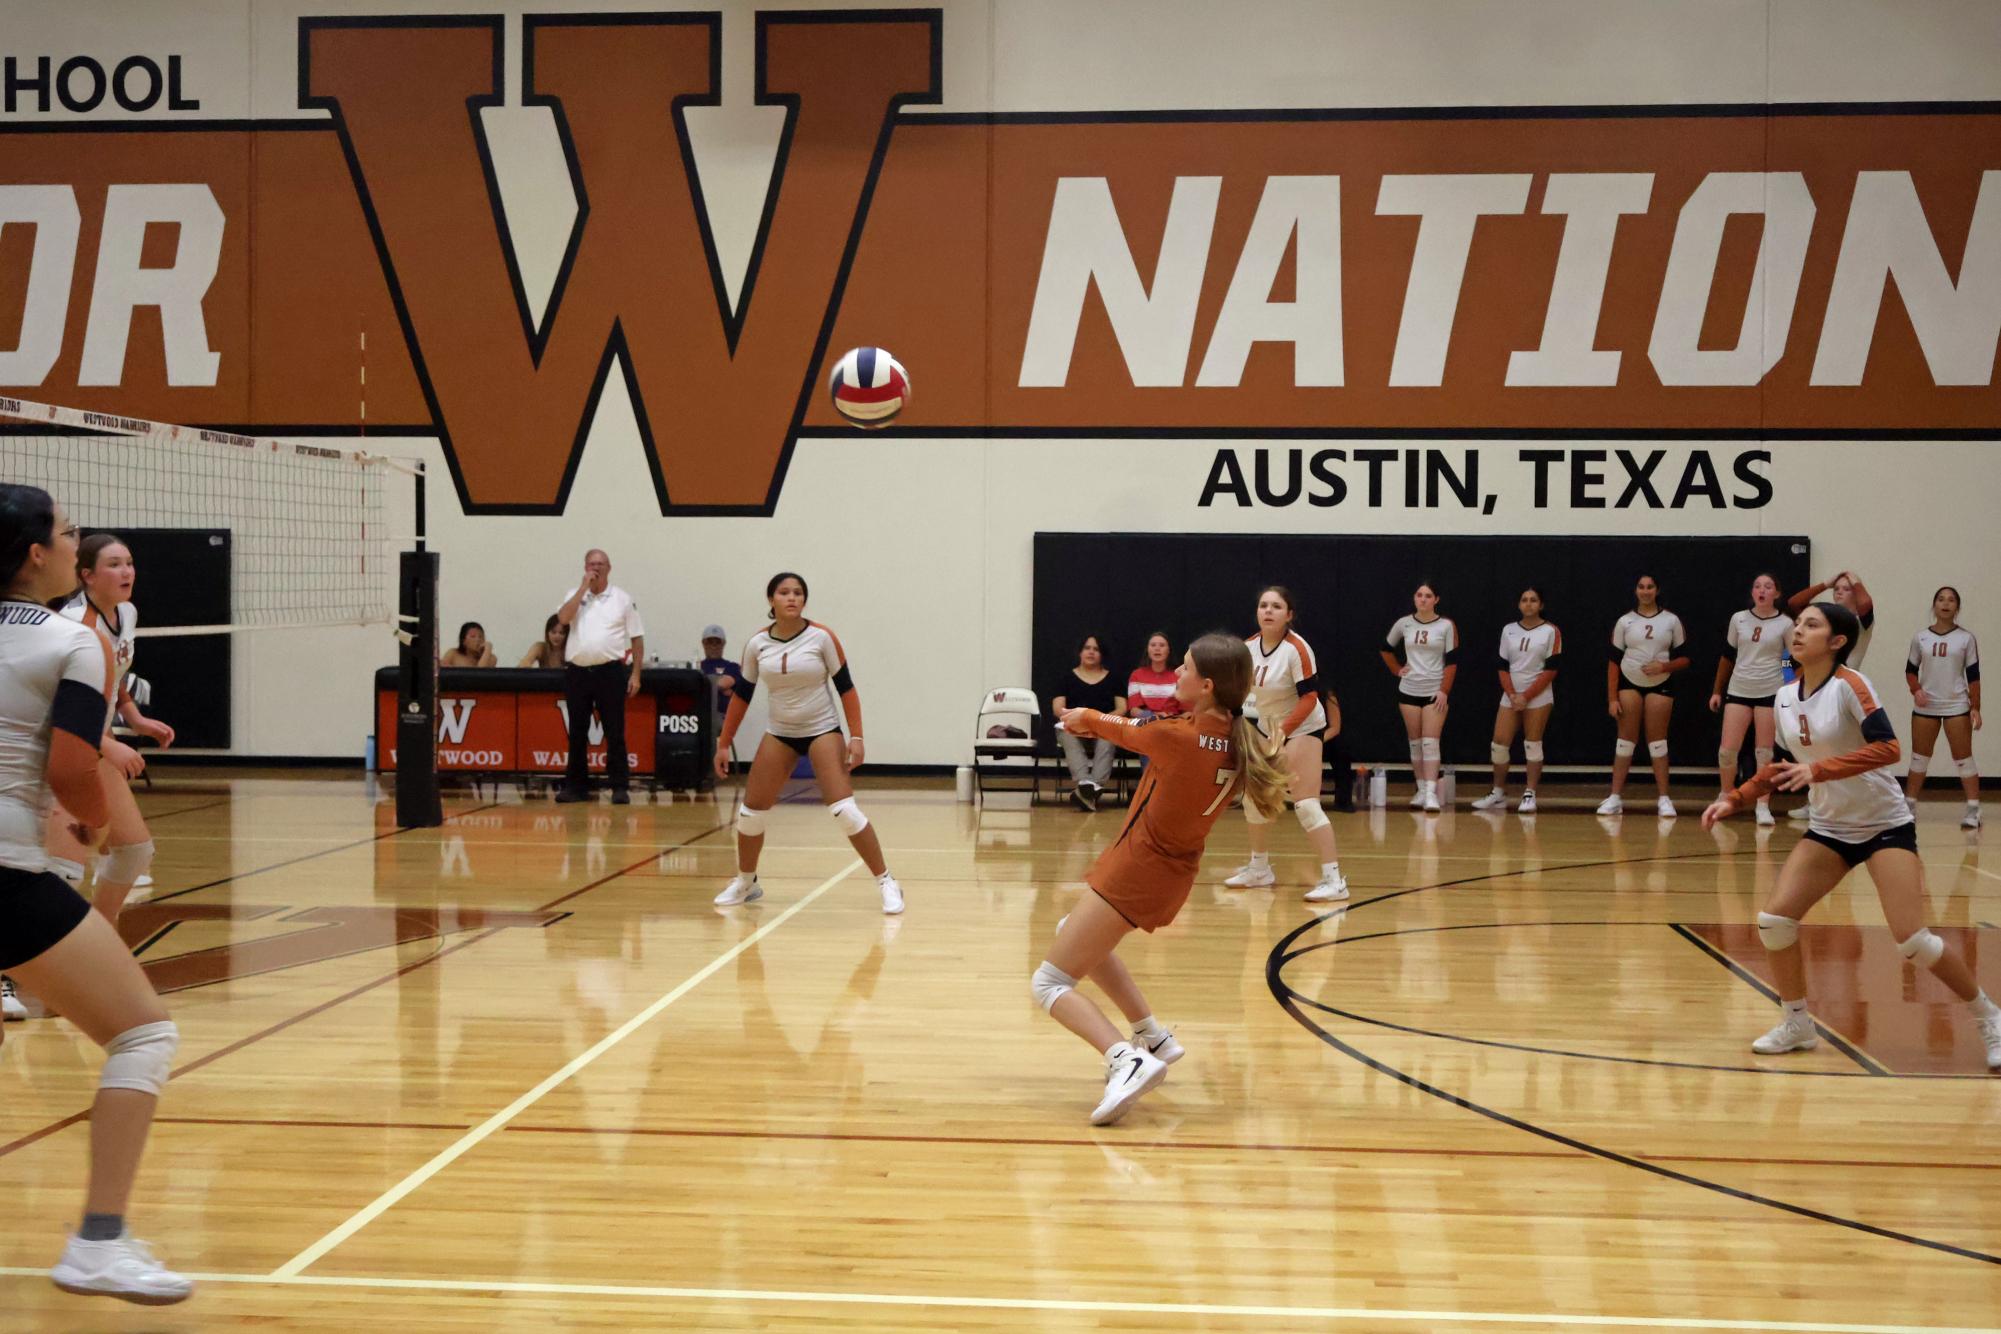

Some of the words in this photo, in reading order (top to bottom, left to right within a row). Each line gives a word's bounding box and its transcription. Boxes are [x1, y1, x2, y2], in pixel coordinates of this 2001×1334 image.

[4, 54, 200, 112] HOOL
[298, 8, 943, 518] W
[1018, 169, 2001, 388] NATION
[1198, 448, 1497, 515] AUSTIN,
[1519, 448, 1774, 509] TEXAS
[1414, 630, 1429, 645] 13
[1644, 624, 1654, 640] 2
[1751, 626, 1762, 643] 8
[1519, 636, 1531, 652] 11
[1931, 641, 1948, 657] 10
[780, 651, 789, 675] 1
[659, 714, 699, 734] POSS
[1798, 714, 1812, 747] 9
[1199, 734, 1229, 753] WEST
[1201, 768, 1238, 816] 7
